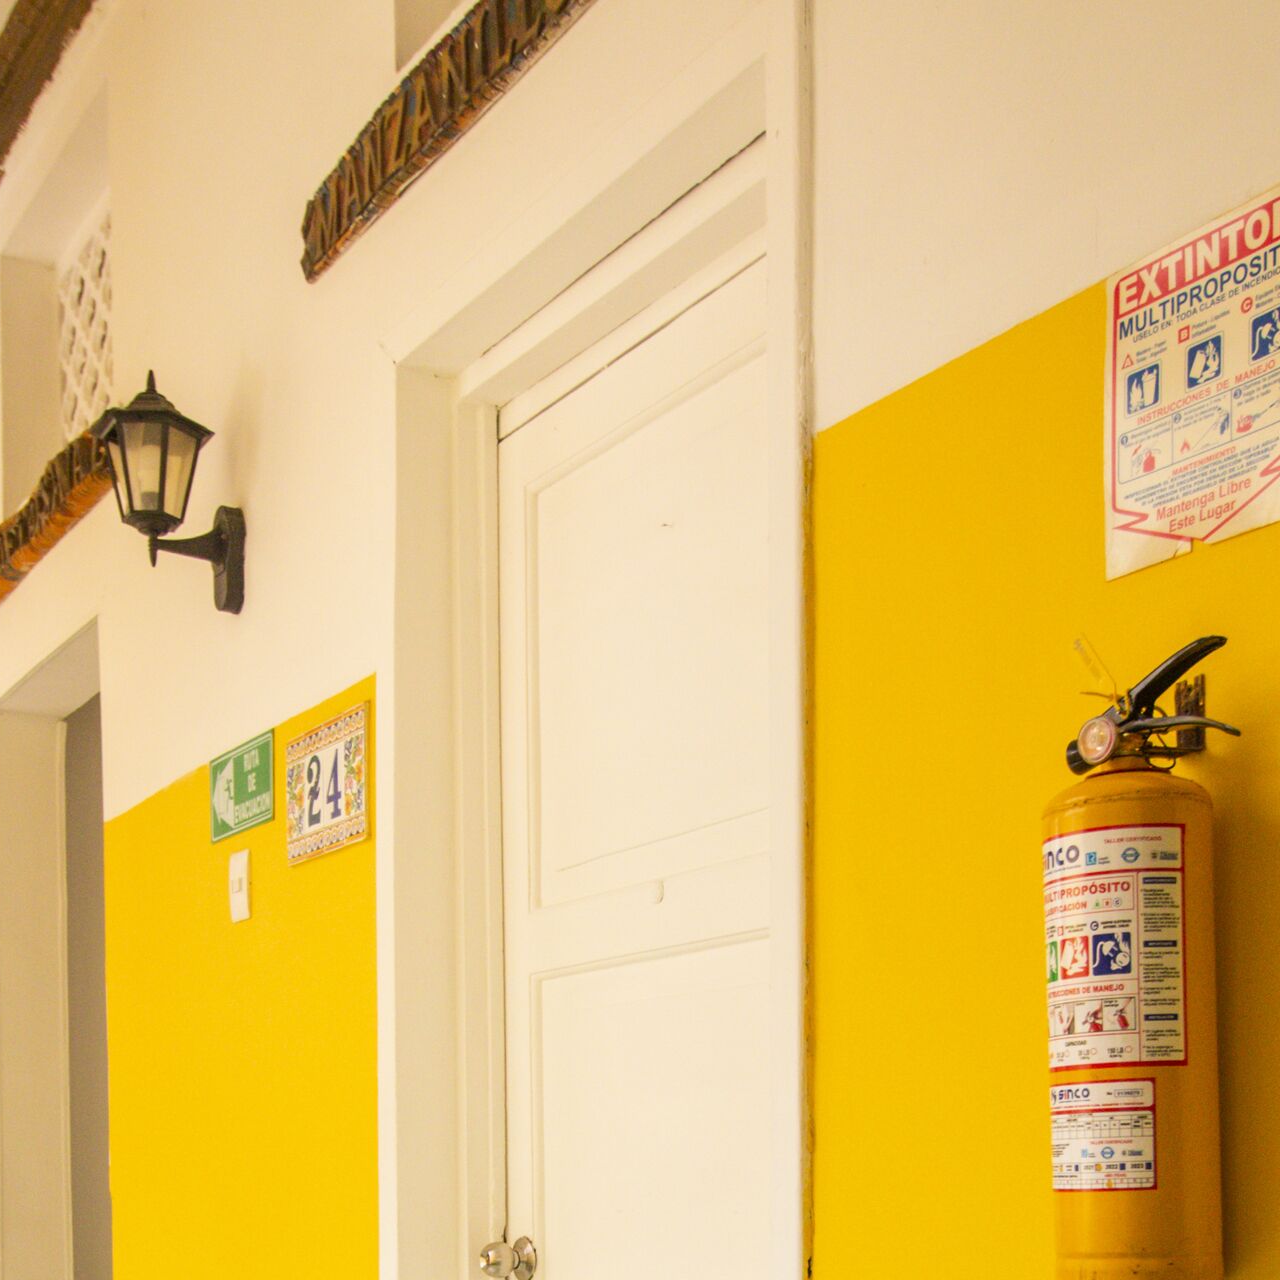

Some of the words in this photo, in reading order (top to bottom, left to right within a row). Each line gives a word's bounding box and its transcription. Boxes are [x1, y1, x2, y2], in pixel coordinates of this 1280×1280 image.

[1176, 307, 1198, 323] TODA
[1199, 295, 1226, 313] CLASE
[1228, 288, 1240, 299] DE
[1137, 388, 1211, 425] INSTRUCCIONES
[1216, 381, 1229, 394] DE
[1234, 360, 1276, 385] MANEJO
[1157, 490, 1214, 520] Mantenga
[1219, 478, 1252, 498] Libre
[1169, 515, 1196, 533] Este
[1200, 500, 1236, 521] Lugar
[247, 772, 257, 793] DE
[306, 748, 342, 829] 24
[1044, 881, 1131, 905] LTIPROPÓSITO
